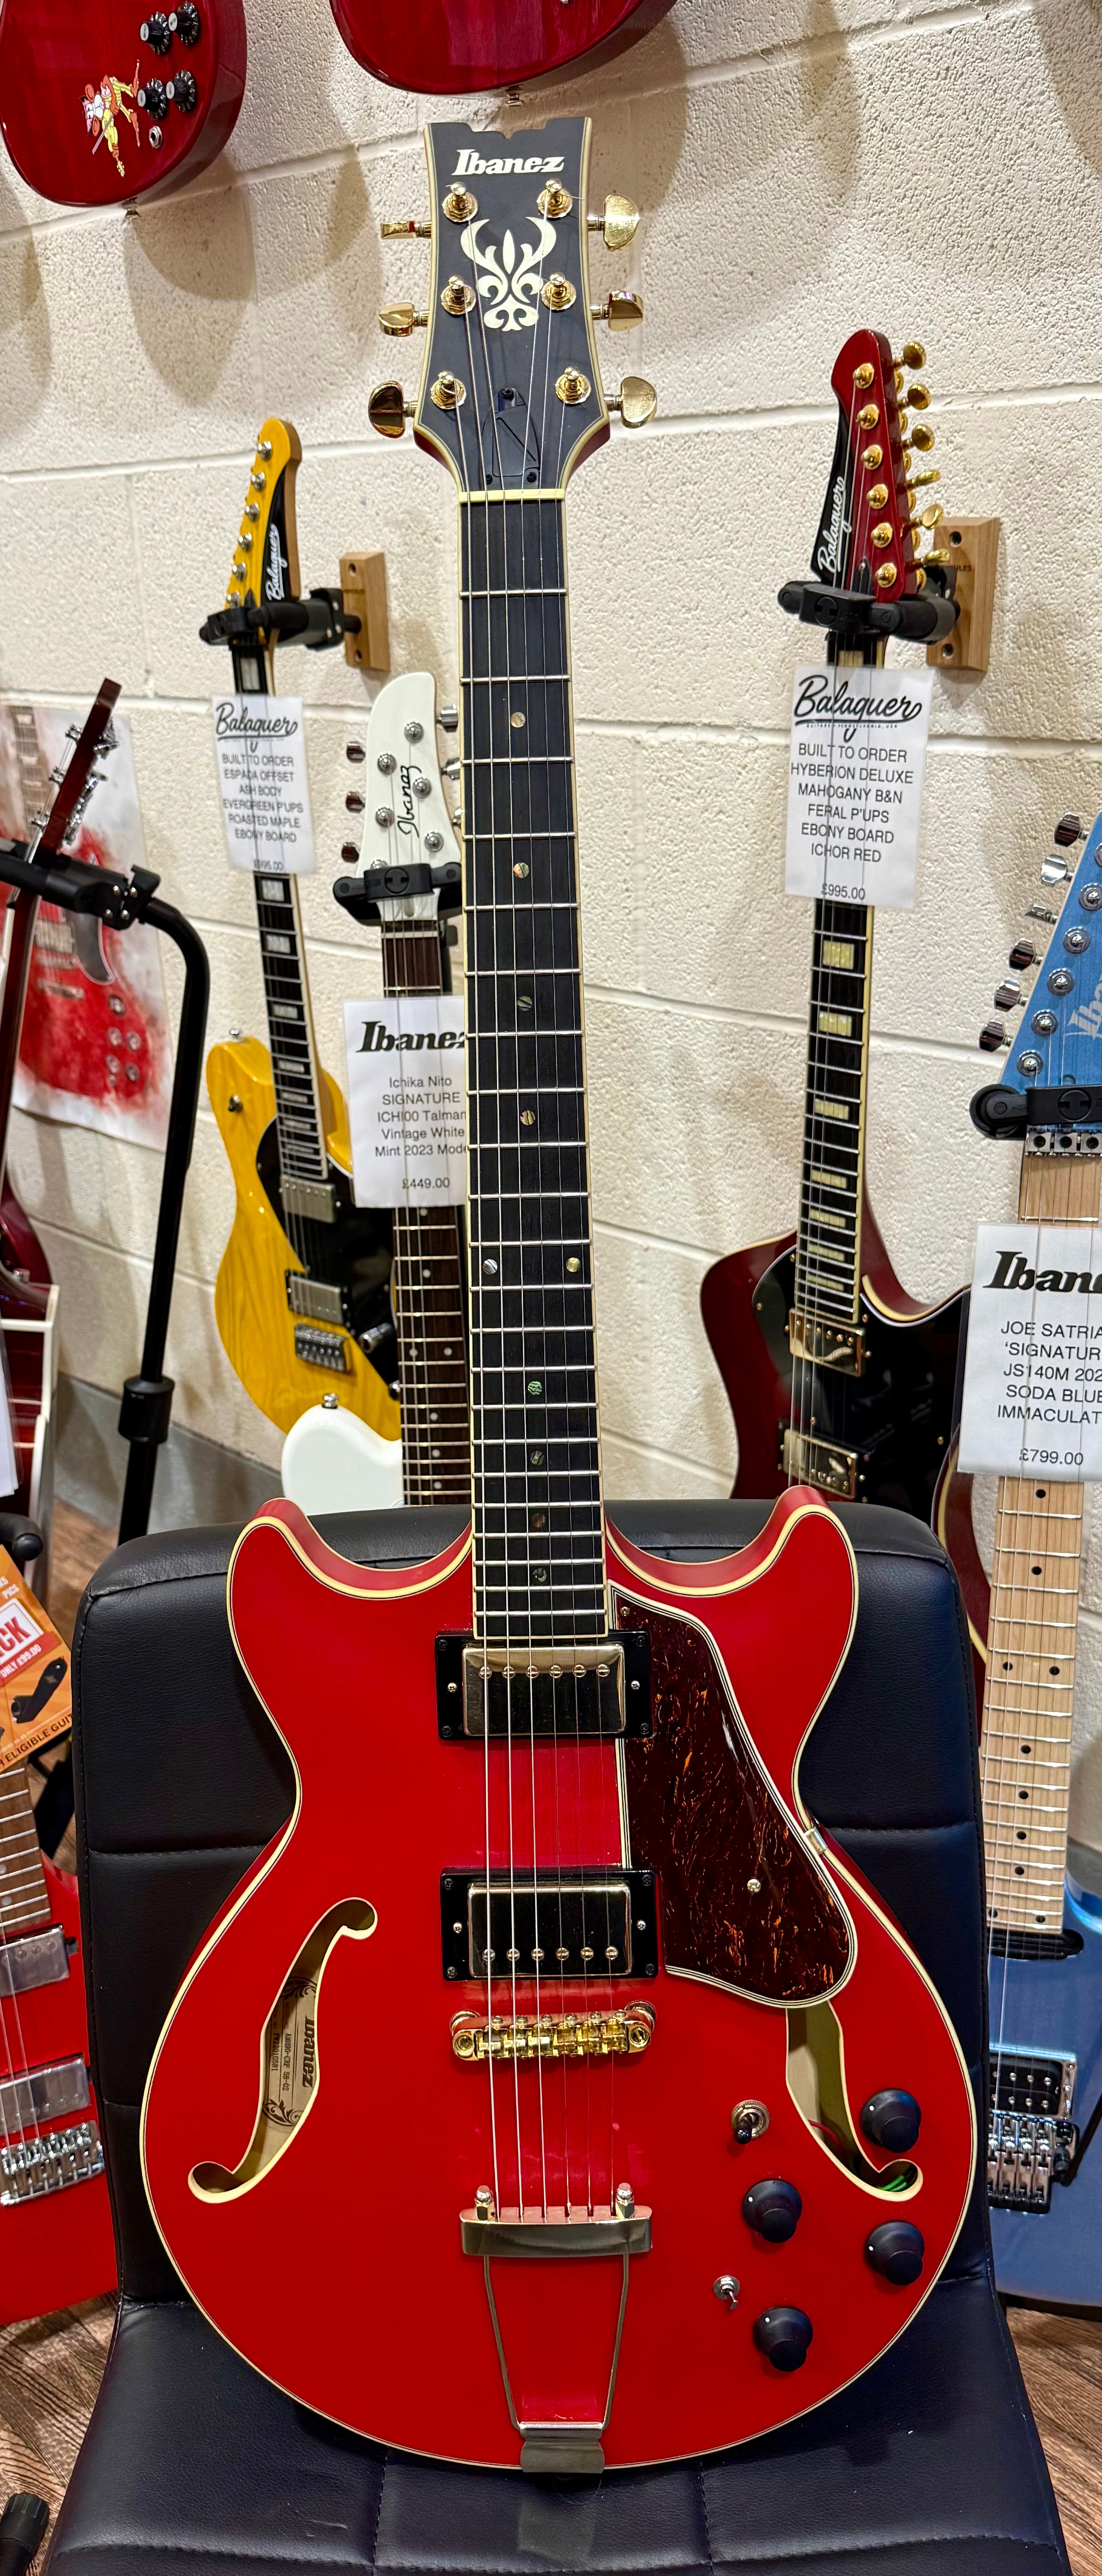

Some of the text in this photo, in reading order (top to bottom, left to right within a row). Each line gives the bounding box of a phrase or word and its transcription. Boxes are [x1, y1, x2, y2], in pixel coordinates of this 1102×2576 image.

[451, 149, 565, 176] Ibanez
[817, 476, 853, 573] Balaguer
[266, 523, 288, 601] Balaguer
[794, 675, 922, 743] Balaguer
[216, 702, 298, 753] Balaguer
[221, 754, 294, 767] BUILT TO ORDER
[798, 743, 907, 763] BUILT TO ORDER
[224, 769, 294, 782] ESPADA OFFSET
[791, 763, 914, 784] HYBERION DELUXE
[239, 785, 282, 797] ASH BODY
[798, 783, 902, 804] MAHOGANY B&N
[222, 799, 275, 811] EVERGREEN
[397, 765, 422, 838] Ibanez
[229, 813, 301, 828] ROASTED MAPLE
[808, 804, 890, 823] FERAL P'UPS
[234, 828, 297, 842] EBONY BOARD
[801, 823, 895, 844] EBONY BOARD
[811, 843, 881, 862] ICHOR RED
[821, 883, 866, 900] £995.00
[389, 1076, 452, 1088] Ichika Nito
[382, 1092, 460, 1105] SIGNATURE
[381, 1127, 465, 1141] Vintage White
[375, 1146, 401, 1156] Mint
[404, 1145, 433, 1156] 2023
[1001, 1321, 1036, 1335] JOE
[1004, 1363, 1069, 1381] JS140M
[1006, 1384, 1056, 1401] SODA
[1019, 1448, 1084, 1466] £799.00
[0, 1616, 31, 1658] CK
[5, 1729, 51, 1762] ELIGIBLE
